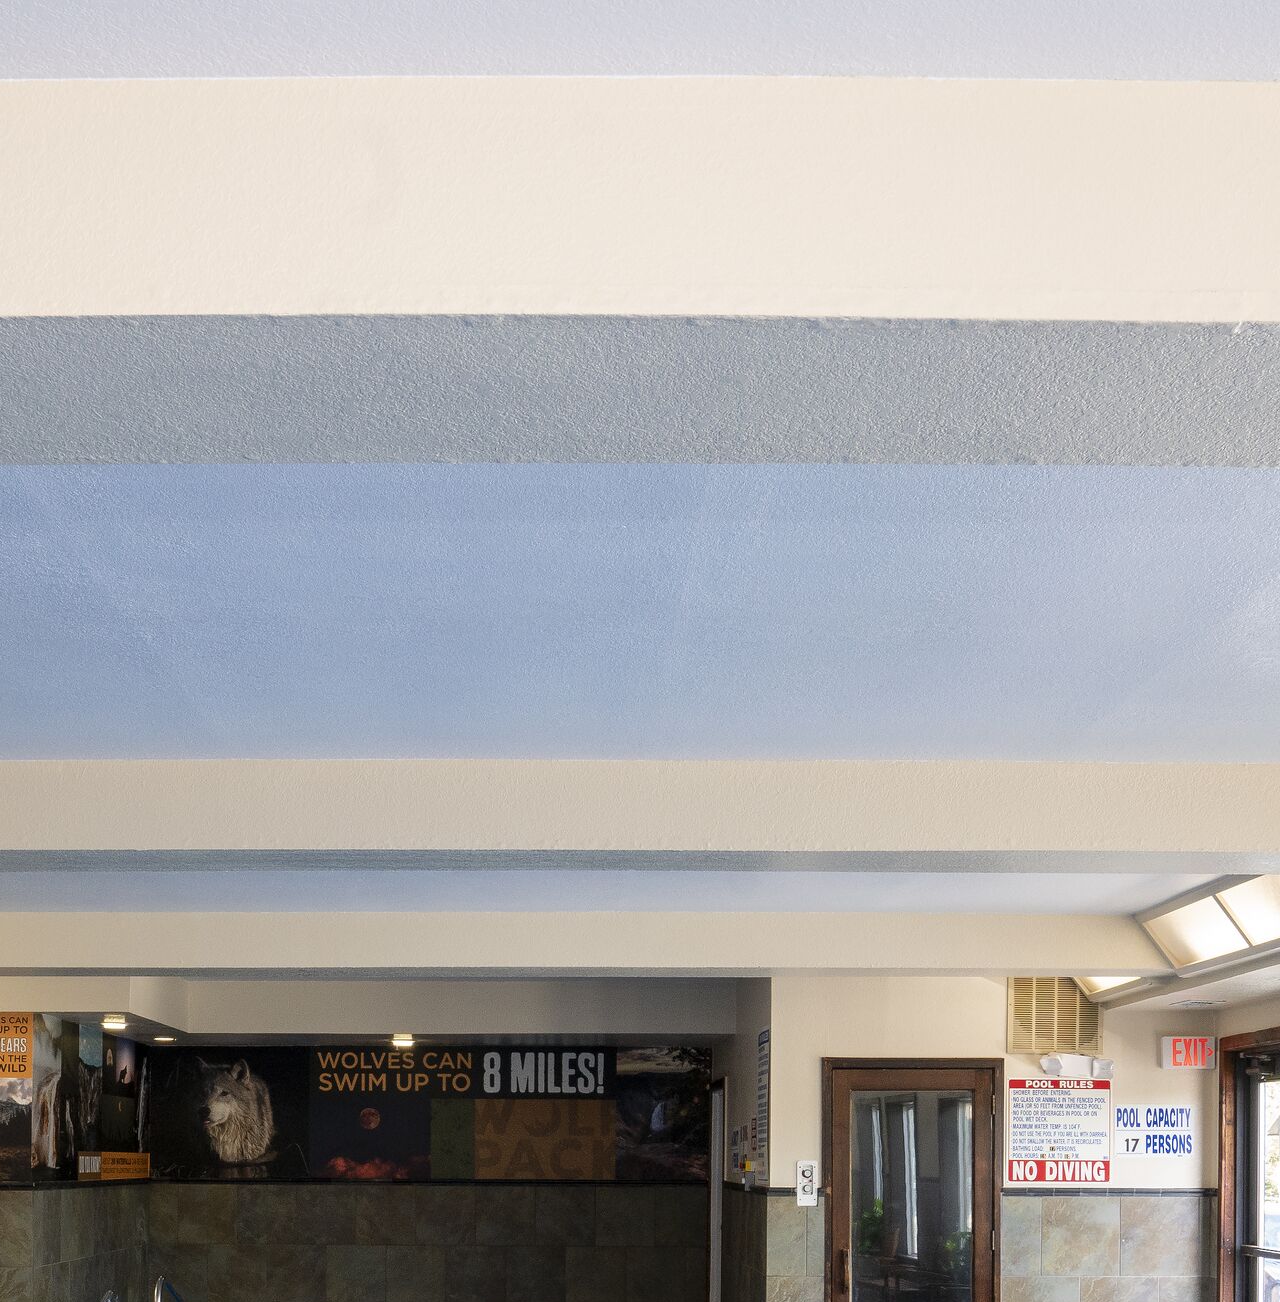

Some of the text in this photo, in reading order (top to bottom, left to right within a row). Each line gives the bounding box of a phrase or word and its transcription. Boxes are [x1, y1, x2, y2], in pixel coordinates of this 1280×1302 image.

[14, 1026, 28, 1034] TO
[317, 1052, 472, 1070] WOLVES CAN
[1172, 1038, 1208, 1066] EXIT
[318, 1073, 471, 1092] SWIM UP TO
[483, 1052, 605, 1094] 8 MILES!
[1116, 1108, 1191, 1128] POOL CAPACITY
[1124, 1134, 1192, 1154] 17 PERSONS
[1012, 1161, 1105, 1181] NO DIVING
